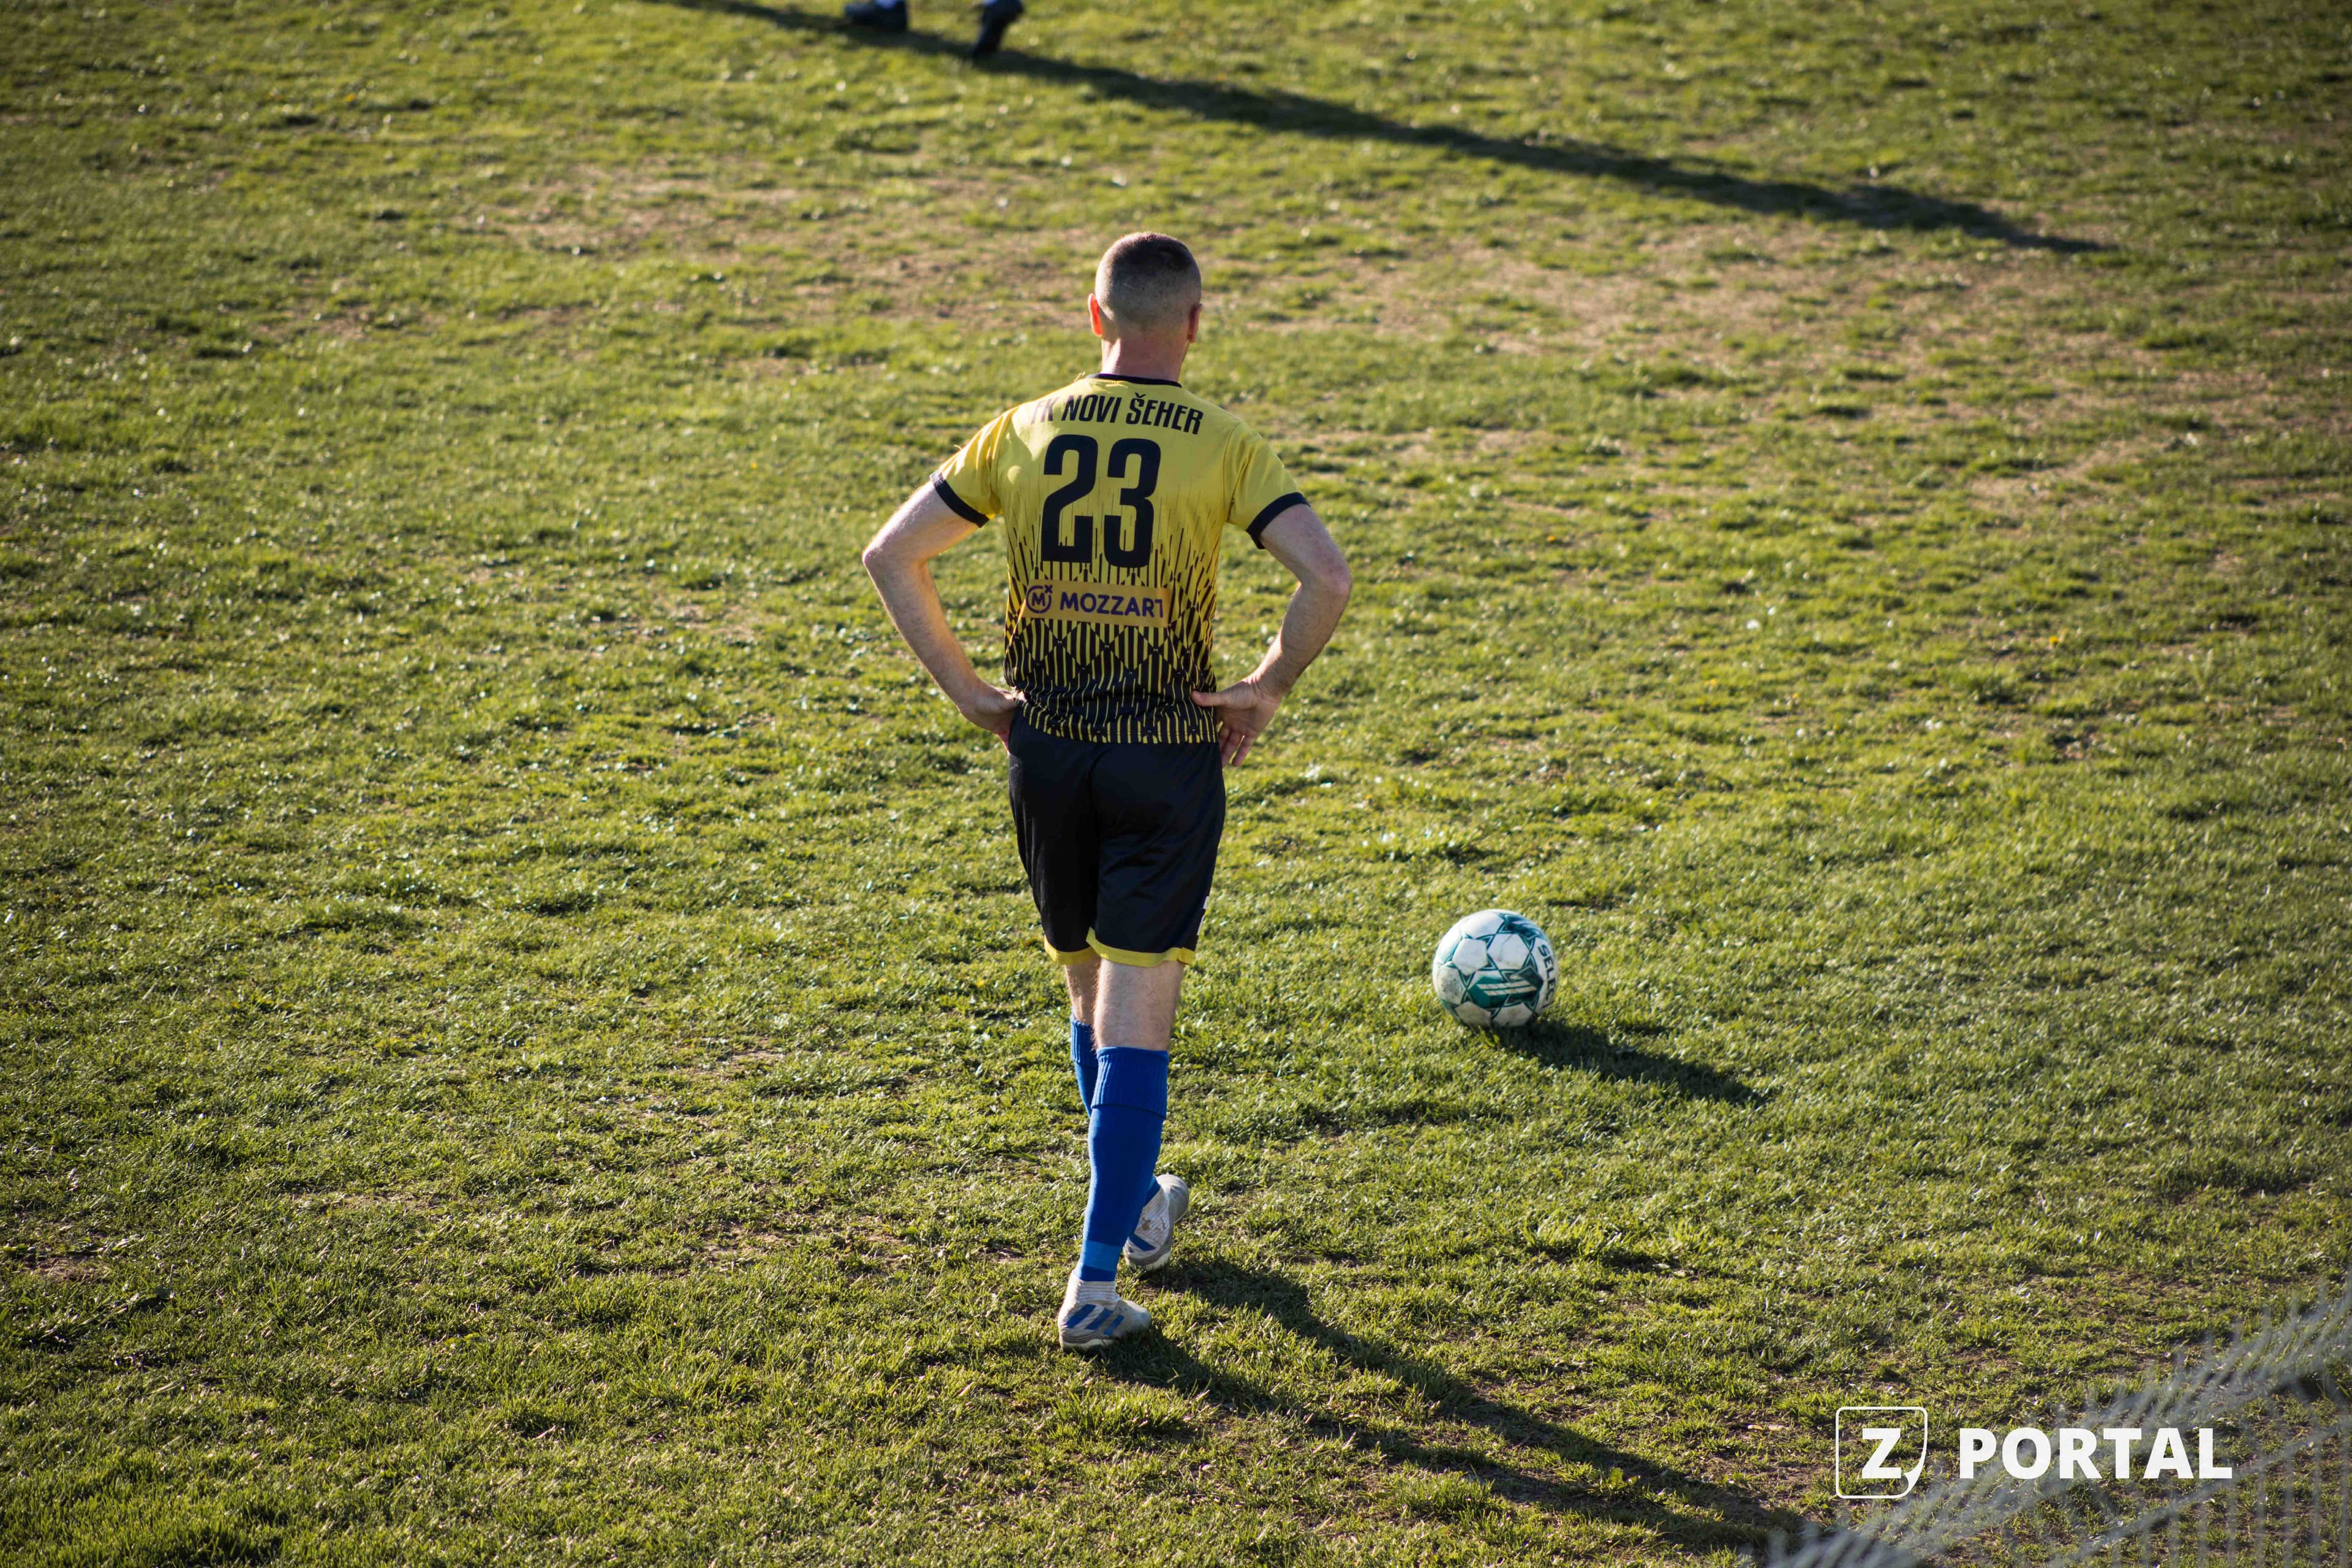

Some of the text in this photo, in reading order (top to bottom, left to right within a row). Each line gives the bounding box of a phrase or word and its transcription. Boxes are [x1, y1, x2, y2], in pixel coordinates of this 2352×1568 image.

[1061, 394, 1122, 423] NOVI
[1126, 392, 1204, 435] ŠEHER
[1042, 434, 1161, 568] 23
[1060, 592, 1164, 618] MOZZART
